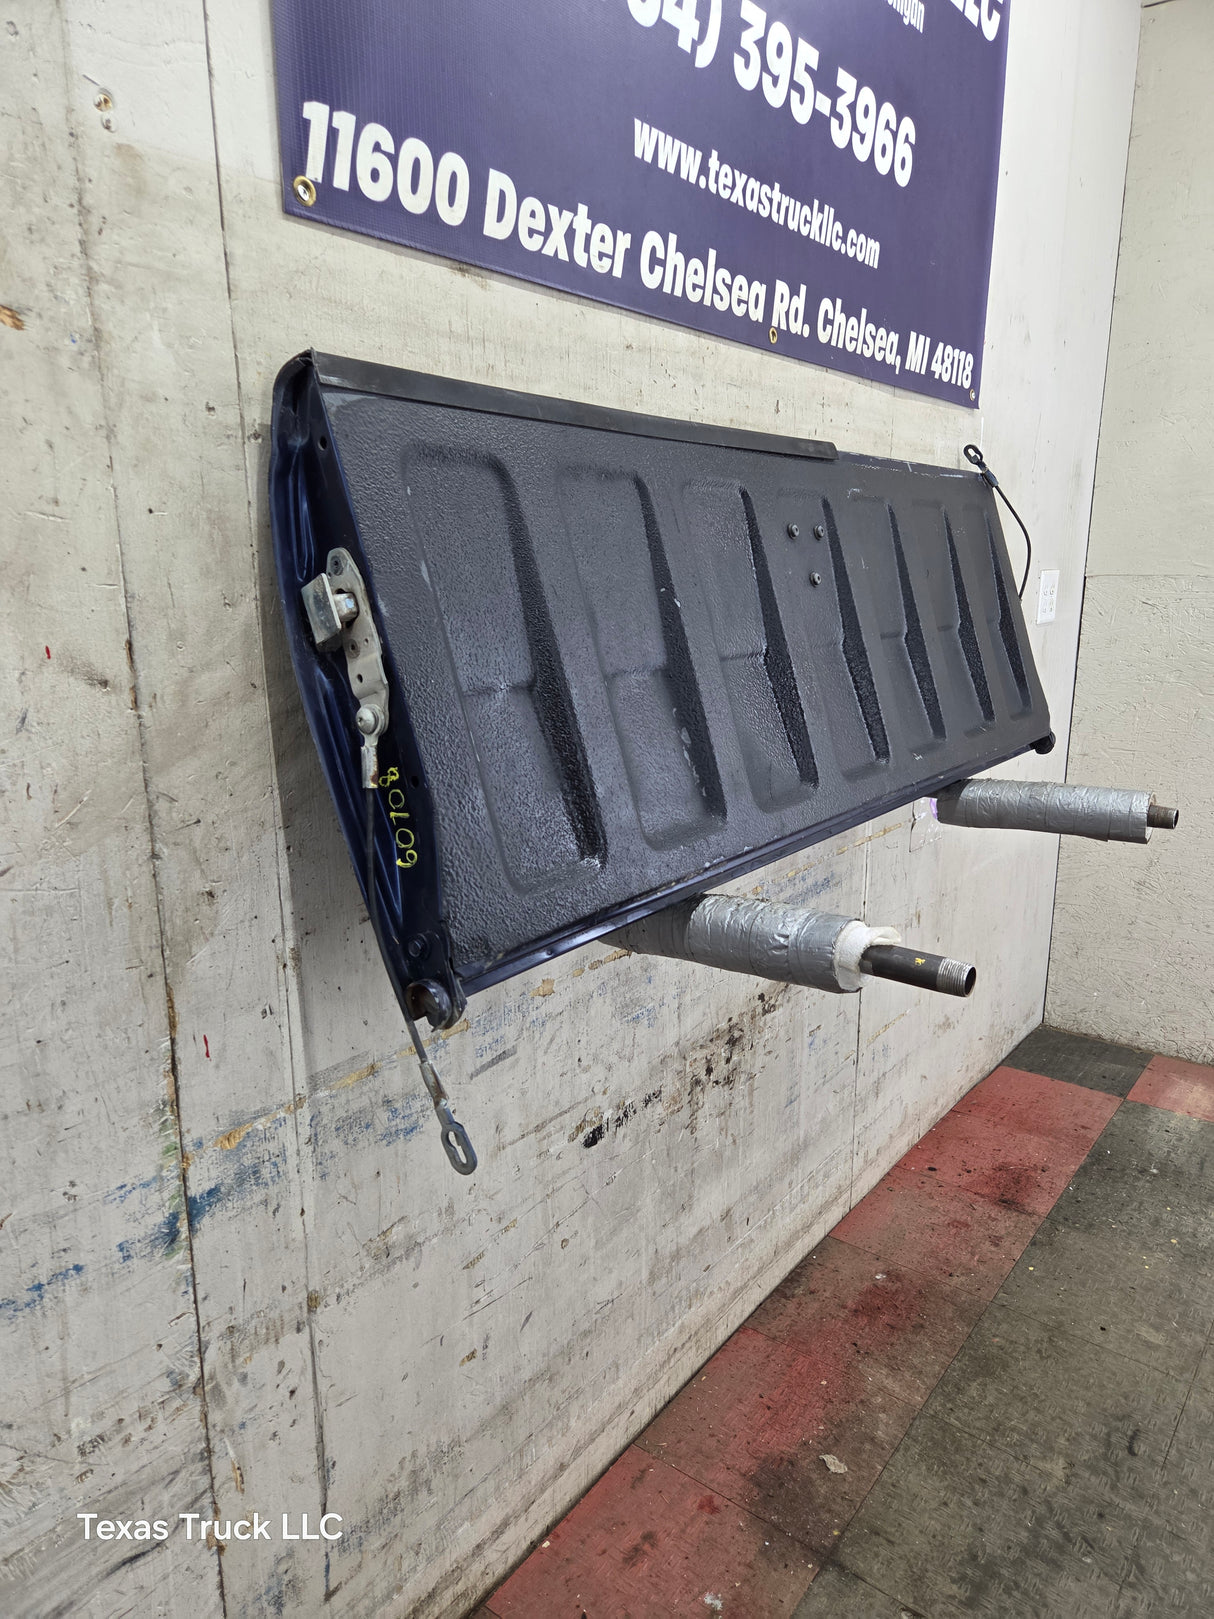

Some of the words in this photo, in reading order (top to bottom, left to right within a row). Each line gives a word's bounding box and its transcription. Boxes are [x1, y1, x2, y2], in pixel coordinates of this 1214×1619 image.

[626, 0, 723, 69] 4)
[733, 0, 916, 188] 395-3966
[302, 100, 470, 226] 11600
[483, 168, 632, 278] Dexter
[640, 230, 767, 322] Chelsea
[771, 279, 810, 338] Rd.
[817, 298, 902, 374] Chelsea,
[905, 331, 931, 375] MI
[930, 340, 975, 389] 48118
[634, 118, 881, 269] www.texastruckllc.com
[379, 766, 418, 869] 60108
